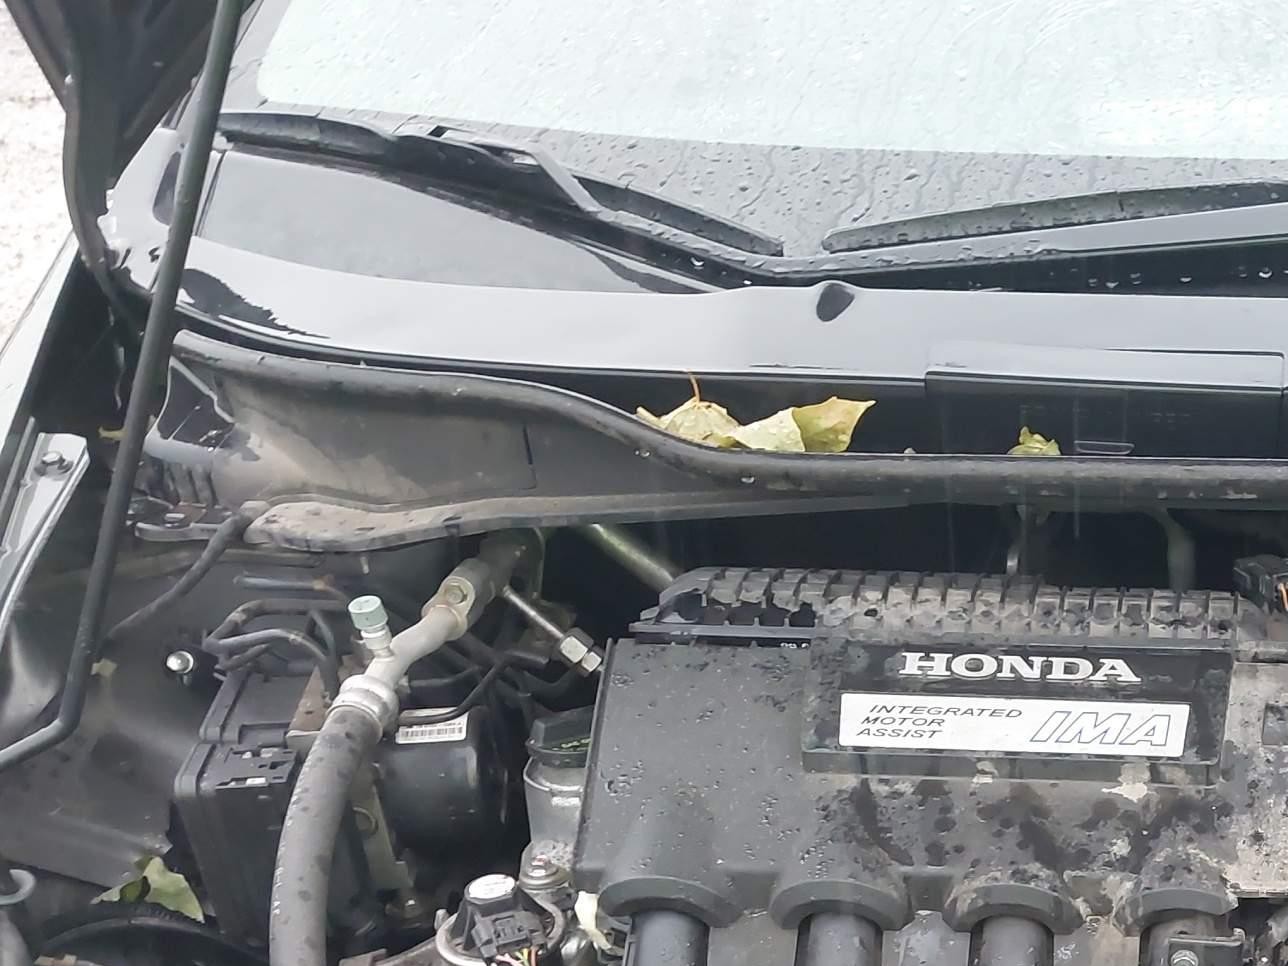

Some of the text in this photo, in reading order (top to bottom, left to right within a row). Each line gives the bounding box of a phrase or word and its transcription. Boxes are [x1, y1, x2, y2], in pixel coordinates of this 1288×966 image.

[898, 652, 1142, 682] HONDA
[868, 704, 1023, 719] INTEGRATED
[860, 715, 946, 728] MOTOR
[1028, 710, 1172, 747] IMA
[855, 727, 944, 739] ASSIST
